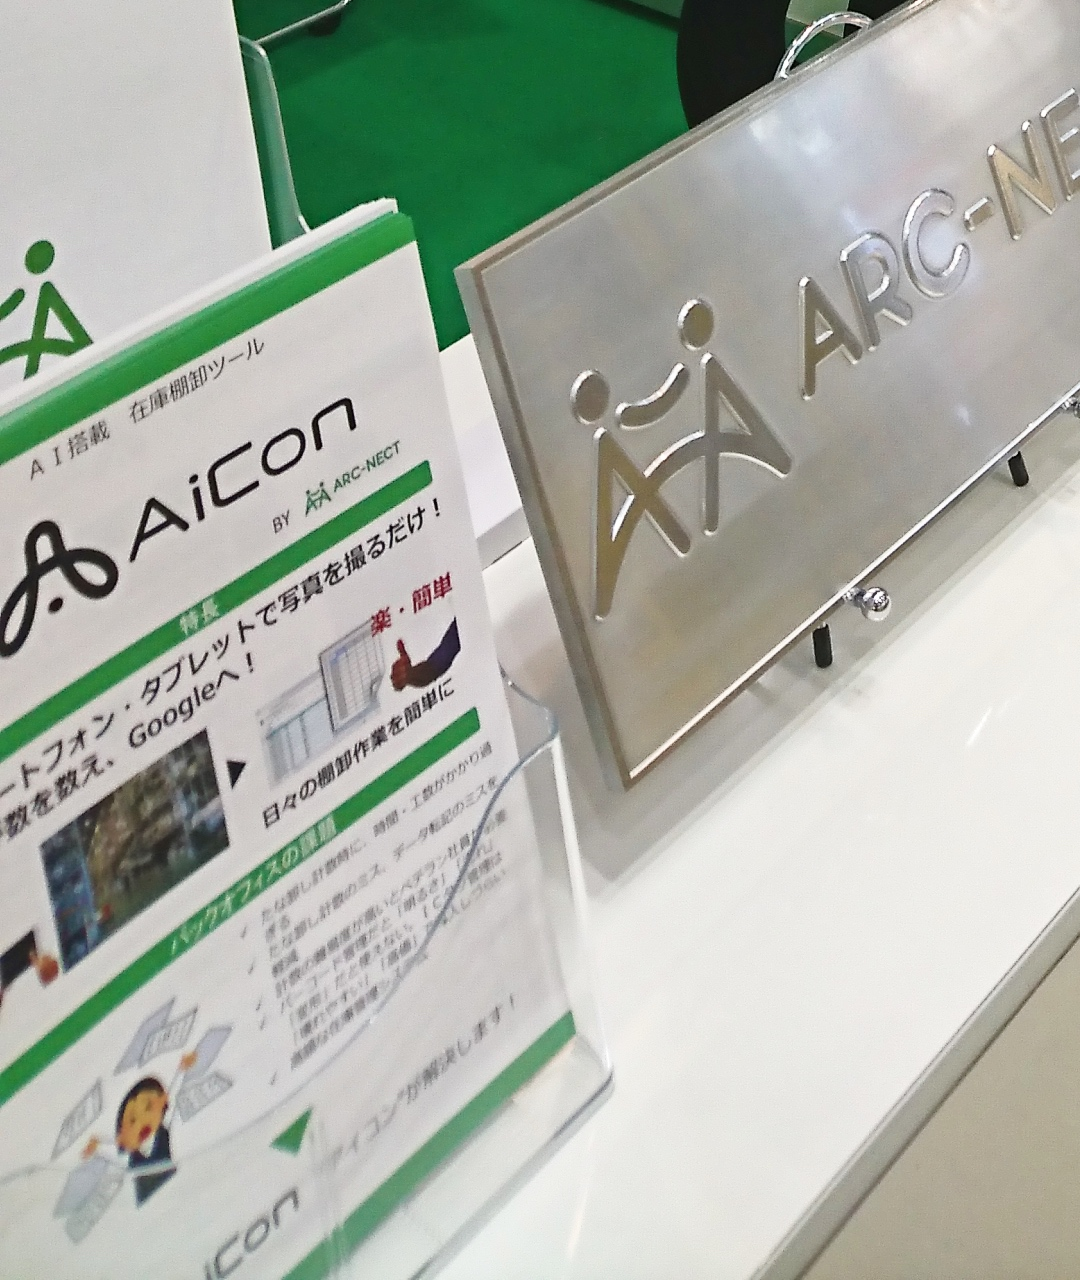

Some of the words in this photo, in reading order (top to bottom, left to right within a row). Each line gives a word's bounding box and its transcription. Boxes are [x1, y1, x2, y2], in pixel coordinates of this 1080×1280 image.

[128, 337, 266, 424] 在庫棚卸ツール
[129, 396, 358, 563] AiCon
[272, 509, 291, 534] BY
[332, 440, 401, 493] ARC-NECT
[370, 571, 453, 637] 楽・簡単
[0, 654, 255, 841] 数を数え、Googleへ！
[262, 679, 456, 829] 日々の棚卸作業を簡単に
